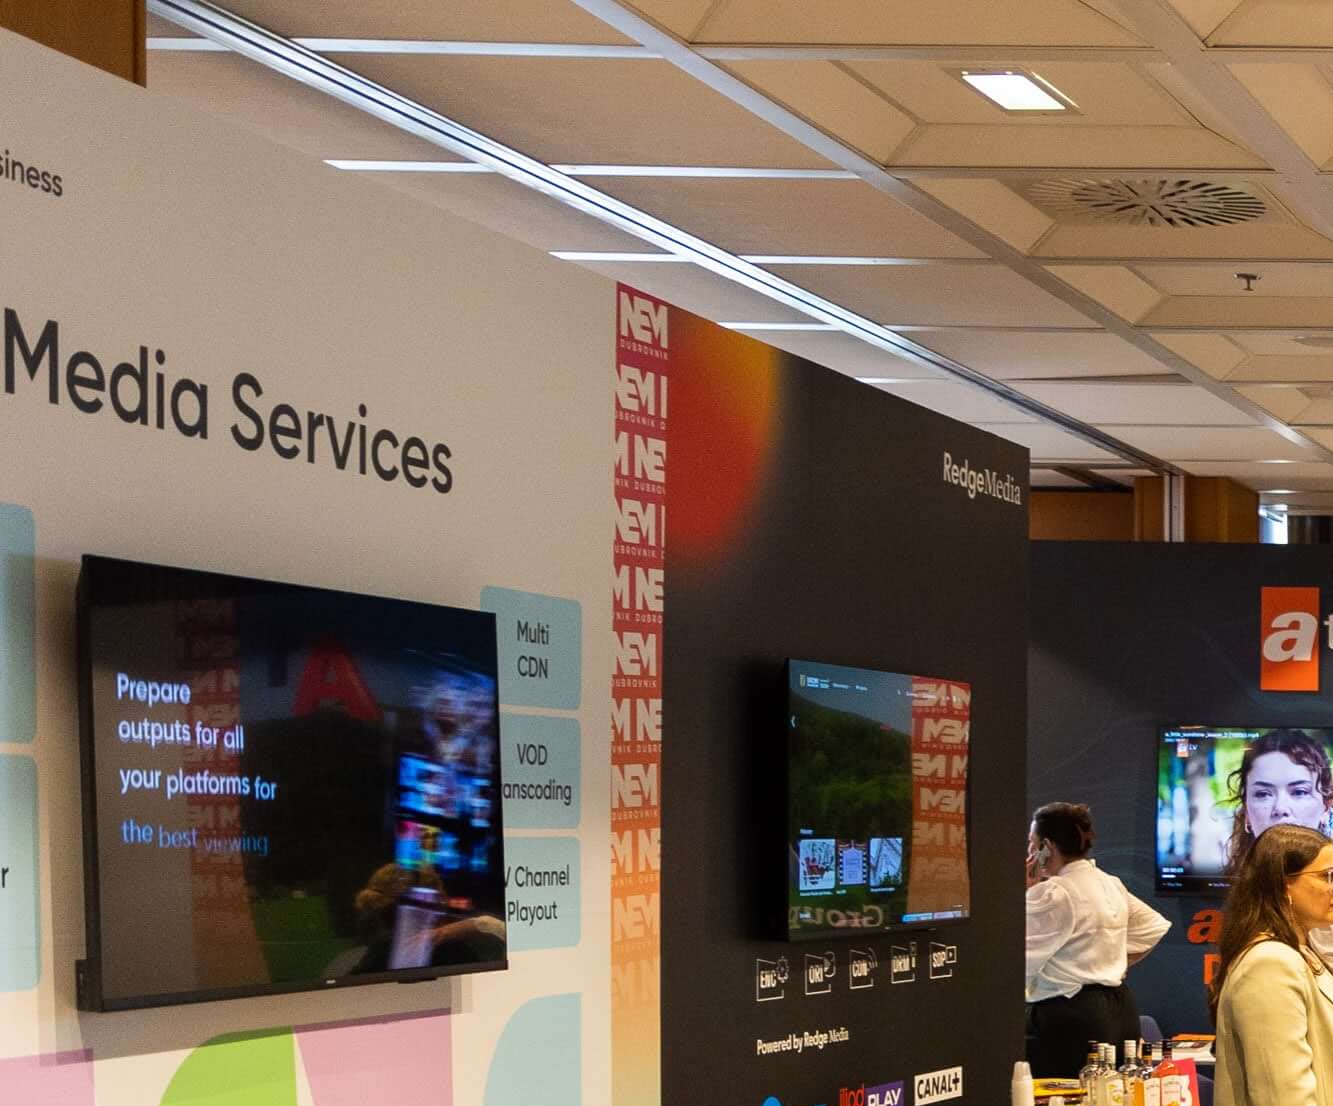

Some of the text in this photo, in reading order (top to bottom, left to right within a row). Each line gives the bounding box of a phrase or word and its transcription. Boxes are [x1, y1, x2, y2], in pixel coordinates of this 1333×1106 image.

[620, 291, 668, 349] NEM
[4, 308, 453, 494] Media Services
[634, 434, 666, 483] NE
[635, 567, 664, 612] NE
[517, 620, 550, 645] Multi
[517, 655, 549, 679] CDN
[116, 672, 191, 707] Prepare
[118, 718, 244, 750] outputs for all
[517, 743, 548, 766] VOD
[120, 768, 277, 800] your platforms for
[502, 779, 572, 806] anscoding
[122, 818, 153, 844] the
[158, 826, 198, 849] best
[514, 864, 570, 888] Channel
[507, 900, 558, 926] Playout
[757, 1034, 792, 1056] Powered
[793, 1033, 803, 1053] by
[804, 1030, 828, 1050] Redge
[917, 1072, 960, 1100] CANAL+
